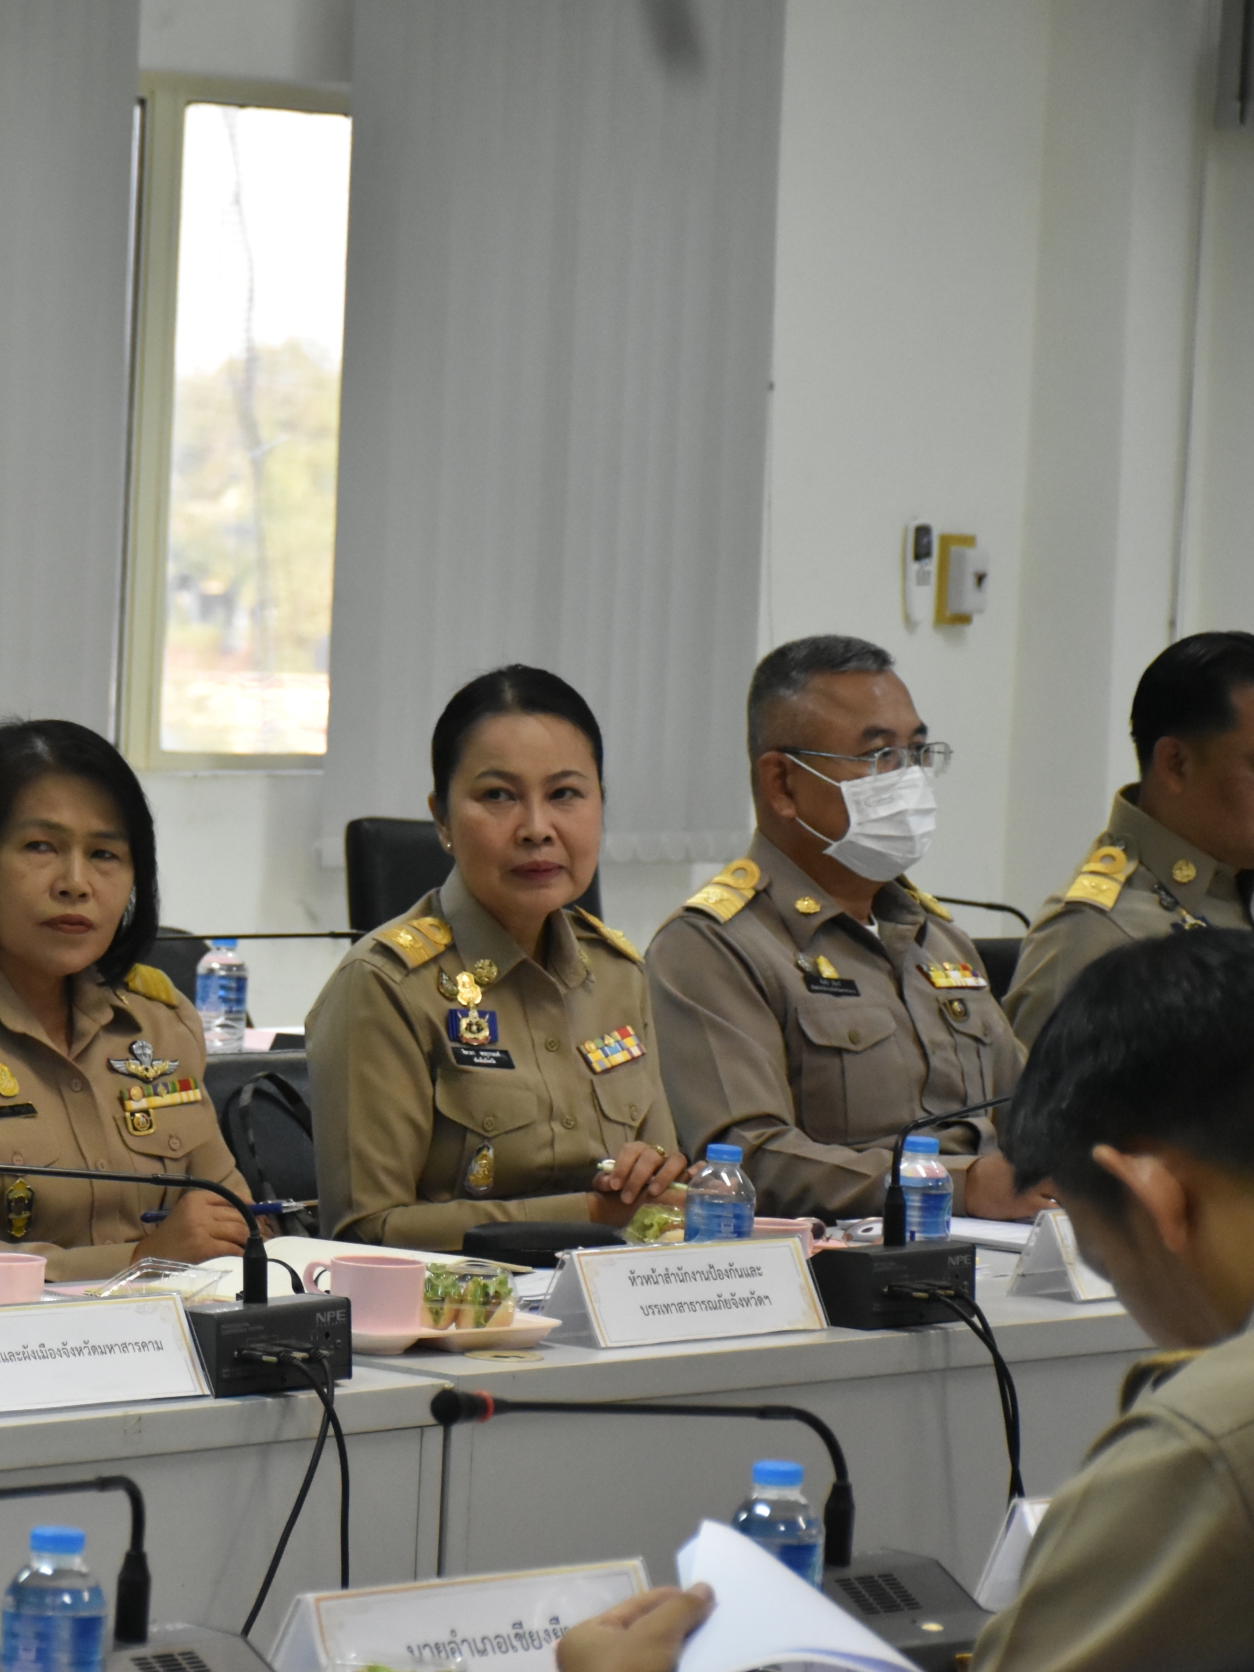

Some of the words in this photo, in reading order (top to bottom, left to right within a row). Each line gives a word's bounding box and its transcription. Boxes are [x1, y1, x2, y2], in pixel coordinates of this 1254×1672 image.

[948, 1254, 973, 1266] NPE
[627, 1261, 764, 1287] หัวหน้าสำนักงานป้องกันและ
[639, 1290, 773, 1317] บรรเทาสาธารณภัยจังหวัดฯ
[315, 1309, 347, 1324] NPE
